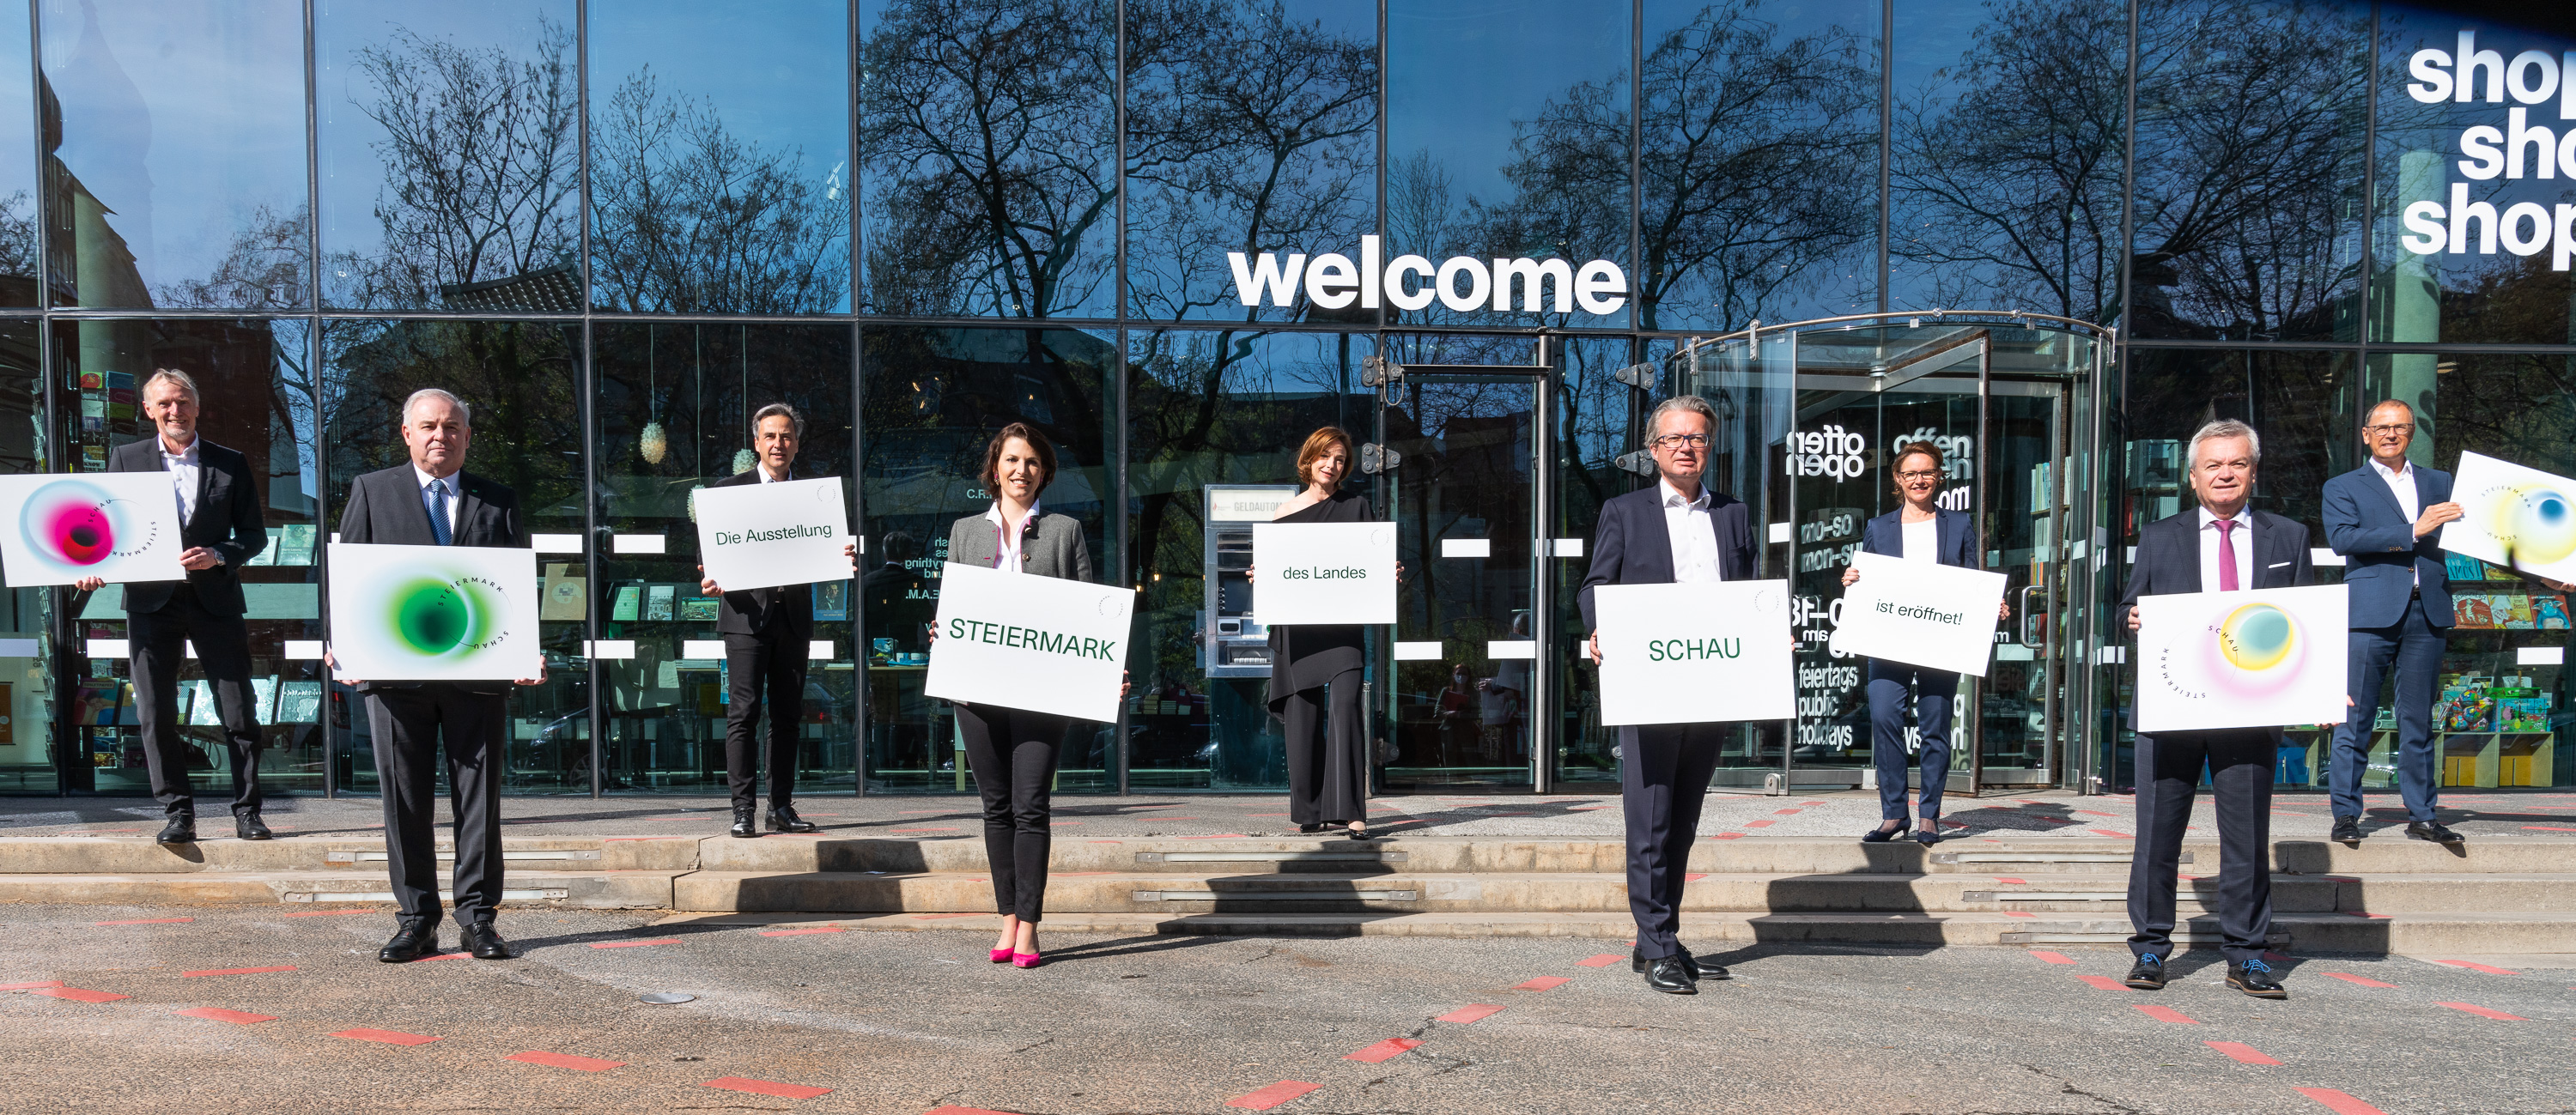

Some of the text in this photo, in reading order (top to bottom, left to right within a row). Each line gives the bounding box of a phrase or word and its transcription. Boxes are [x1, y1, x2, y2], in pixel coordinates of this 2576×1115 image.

[1228, 234, 1627, 315] welcome
[966, 488, 993, 500] C.R.
[2481, 485, 2531, 508] STEIERMARK
[88, 499, 111, 523] SCHAU
[112, 521, 157, 557] STEIERMARK
[715, 524, 832, 546] Die Ausstellung
[2487, 531, 2518, 541] SCHAU
[1283, 566, 1366, 579] des Landes
[437, 577, 503, 607] STEIERMARK
[1875, 598, 1963, 626] ist eröffnet!
[473, 631, 509, 650] SCHAU
[949, 618, 1116, 662] STEIERMARK
[1649, 637, 1741, 662] SCHAU
[2208, 625, 2239, 652] SCHAU
[1799, 660, 1859, 694] feiertags
[2160, 648, 2206, 699] STEIERMARK
[1799, 689, 1839, 724] public
[1798, 718, 1853, 752] holidays
